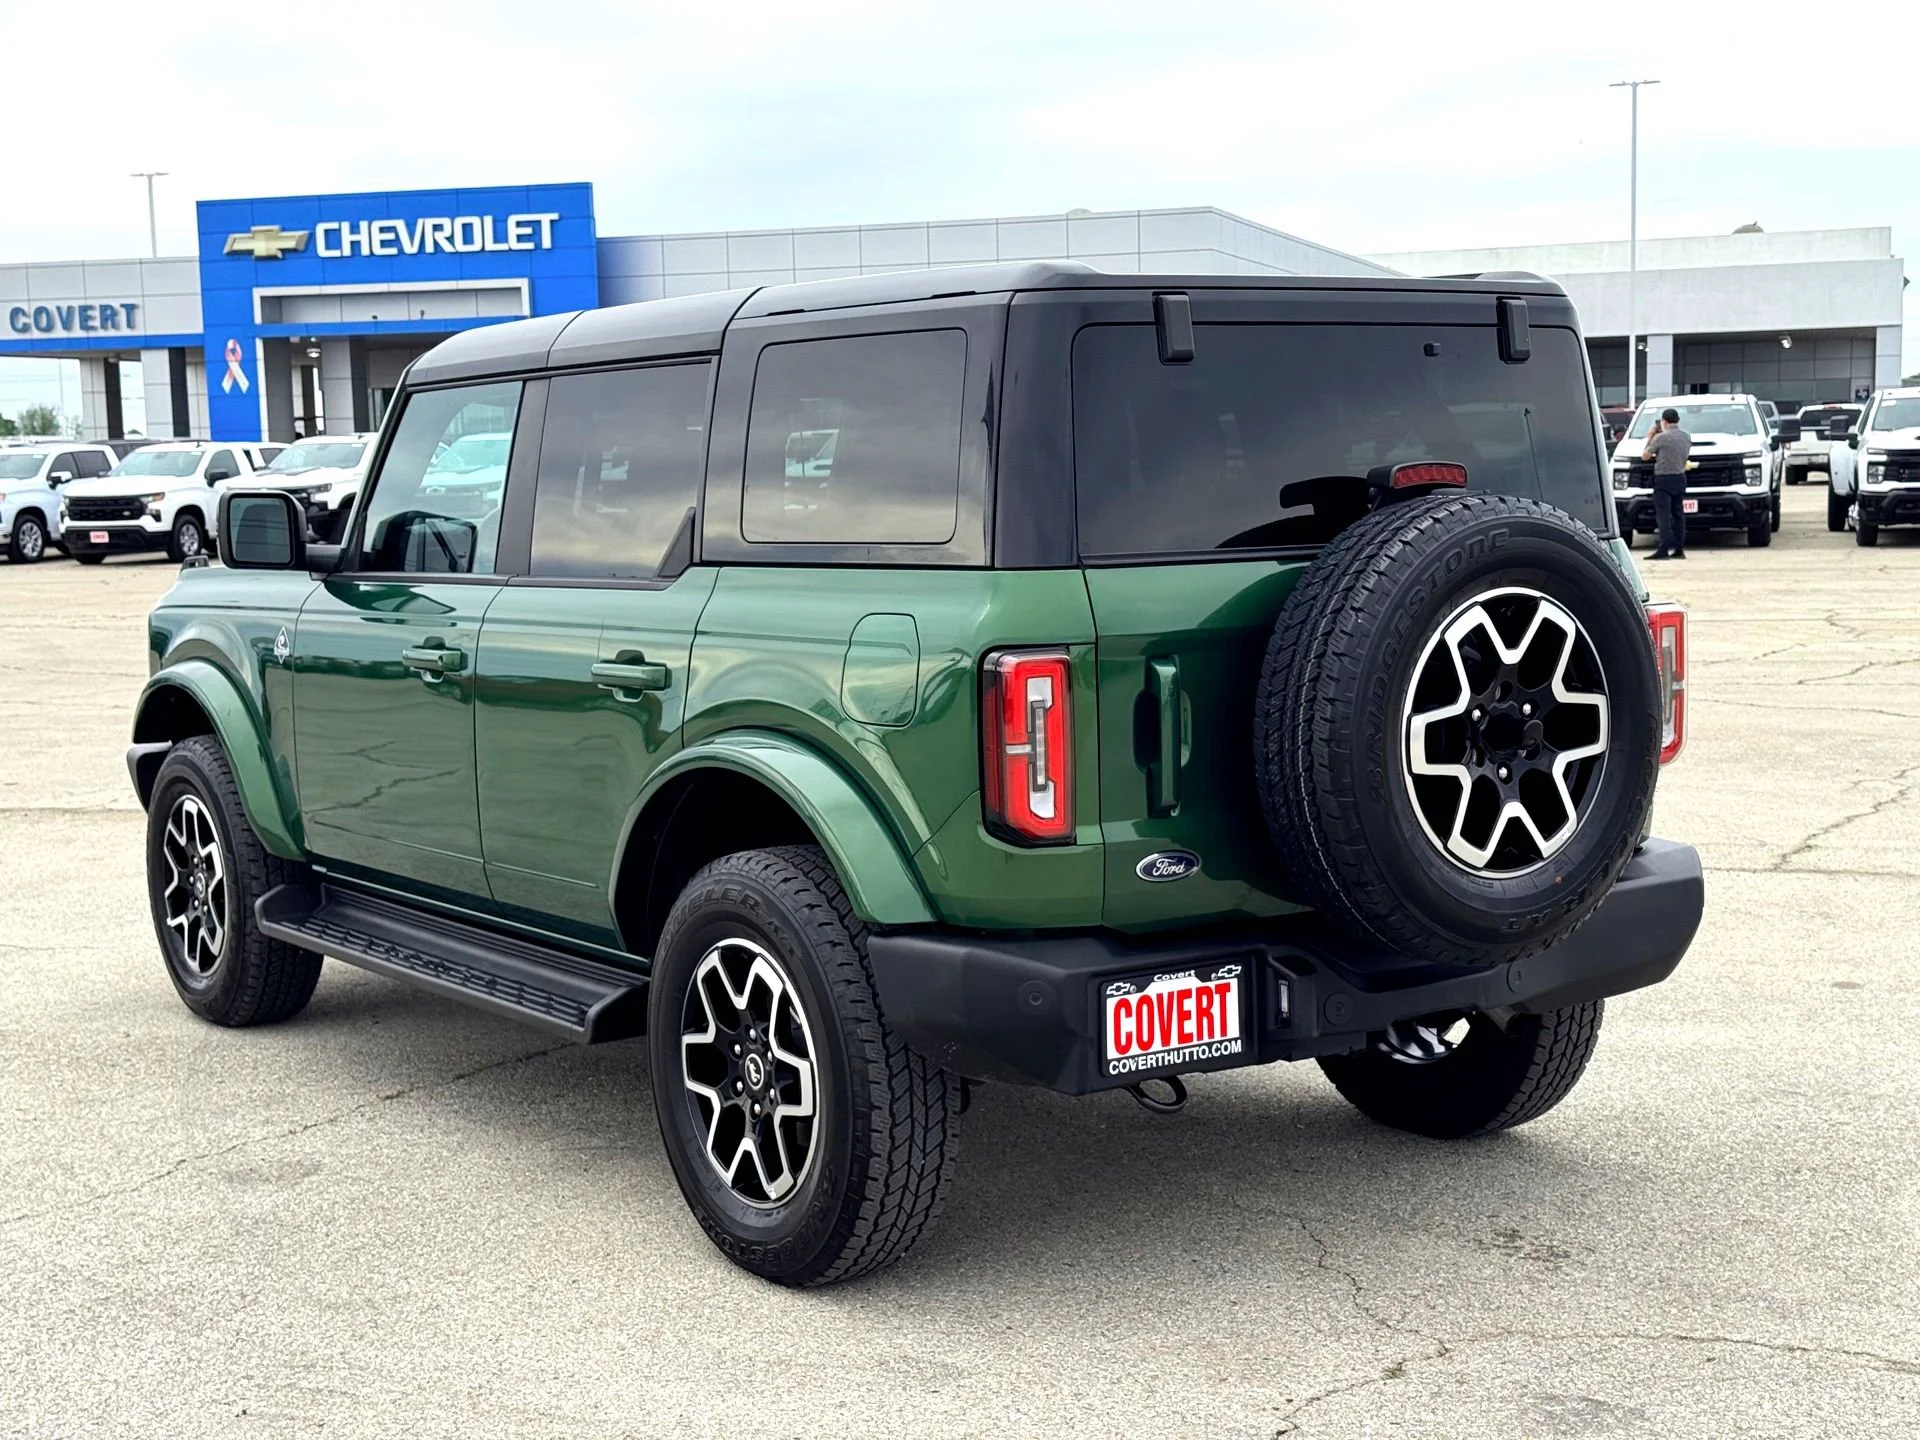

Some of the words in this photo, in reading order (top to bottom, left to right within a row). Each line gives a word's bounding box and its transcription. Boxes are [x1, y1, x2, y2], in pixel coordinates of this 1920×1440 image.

[315, 213, 560, 259] CHEVROLET
[9, 302, 139, 334] COVERT
[1365, 526, 1511, 806] BRIDGESTONE
[1152, 857, 1186, 876] Ford
[1153, 969, 1196, 982] Covert
[1113, 982, 1231, 1056] COVERT
[1109, 1039, 1242, 1076] COVERTHUTTO.COM
